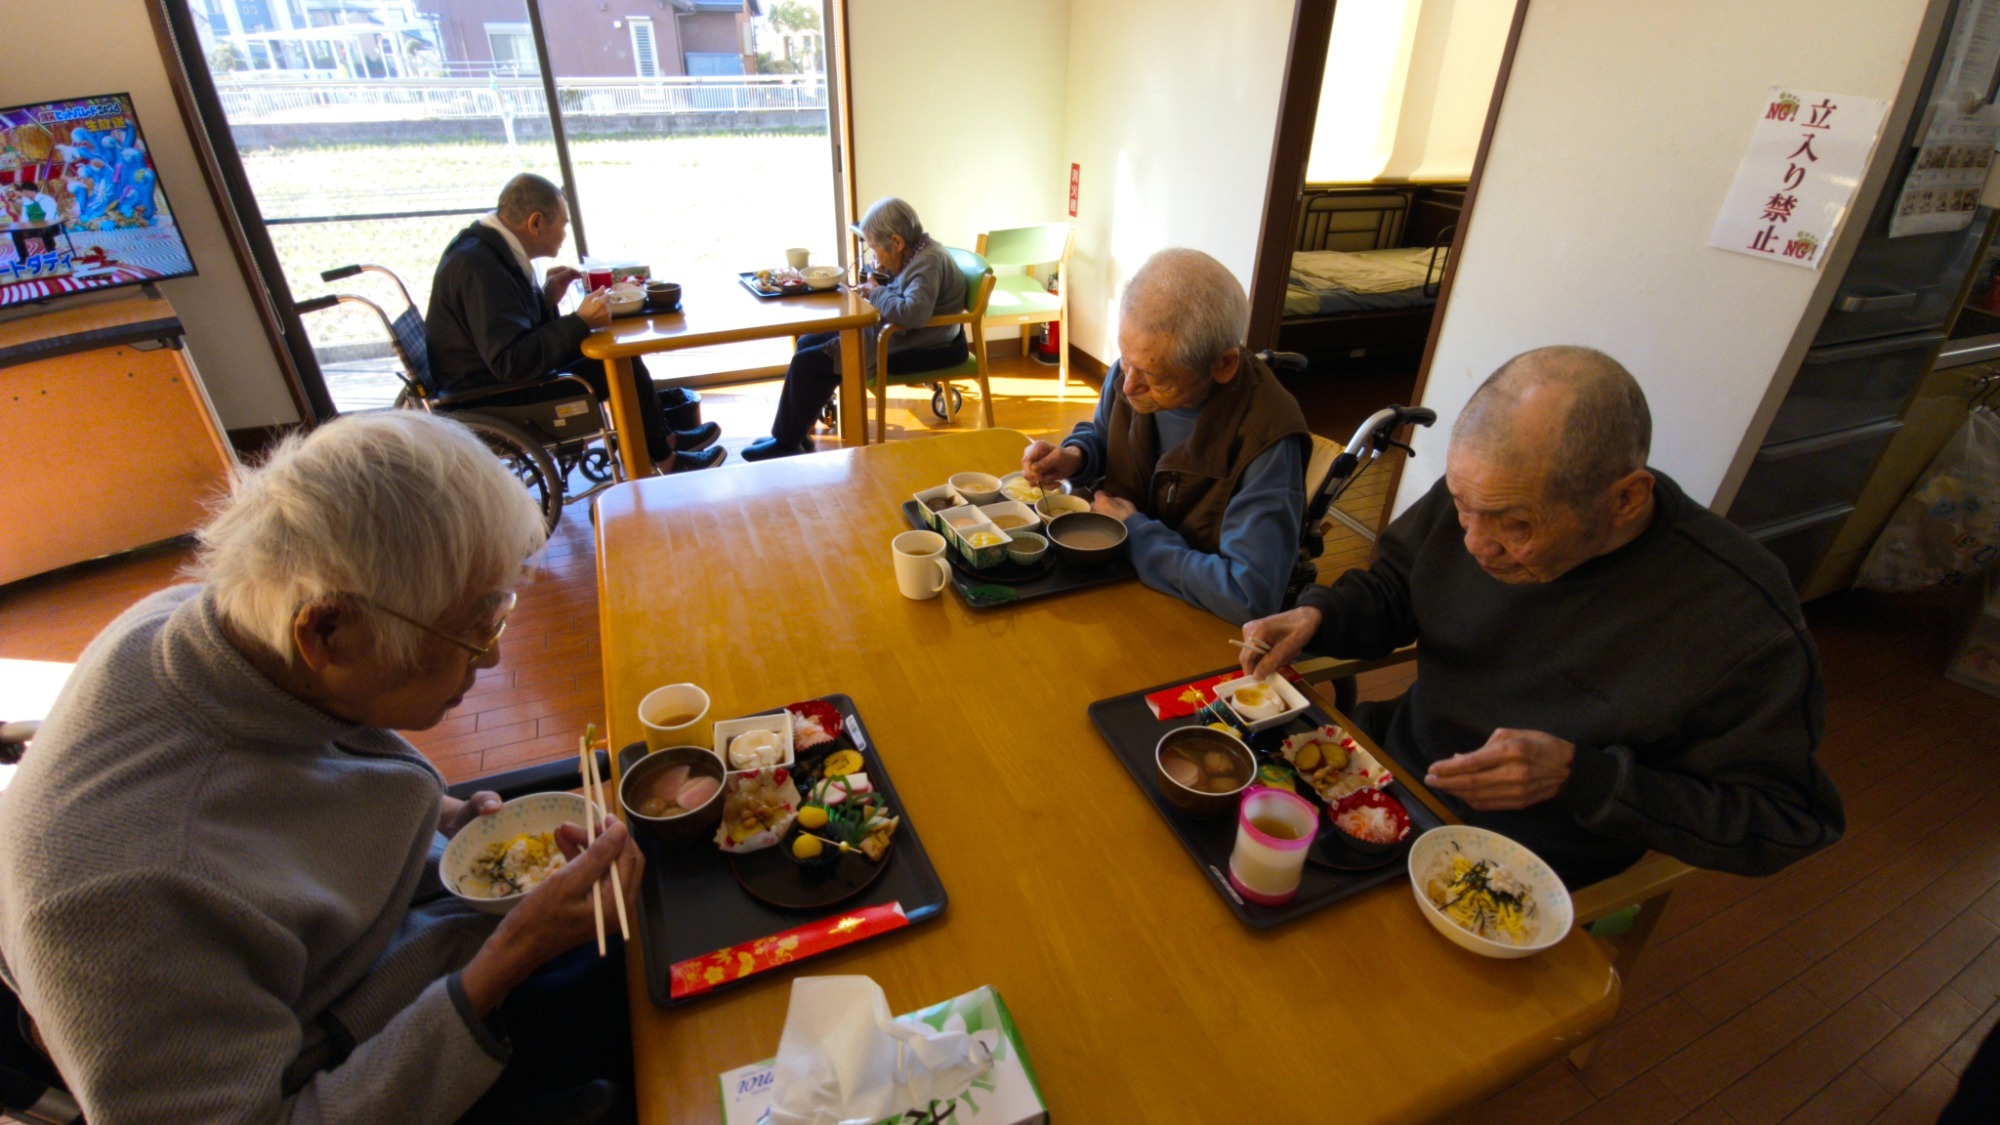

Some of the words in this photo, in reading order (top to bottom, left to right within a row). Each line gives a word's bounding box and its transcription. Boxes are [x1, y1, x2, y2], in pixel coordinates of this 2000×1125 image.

[1765, 102, 1800, 122] NG!
[1746, 98, 1838, 254] 立入り禁止
[1782, 240, 1818, 261] NG!
